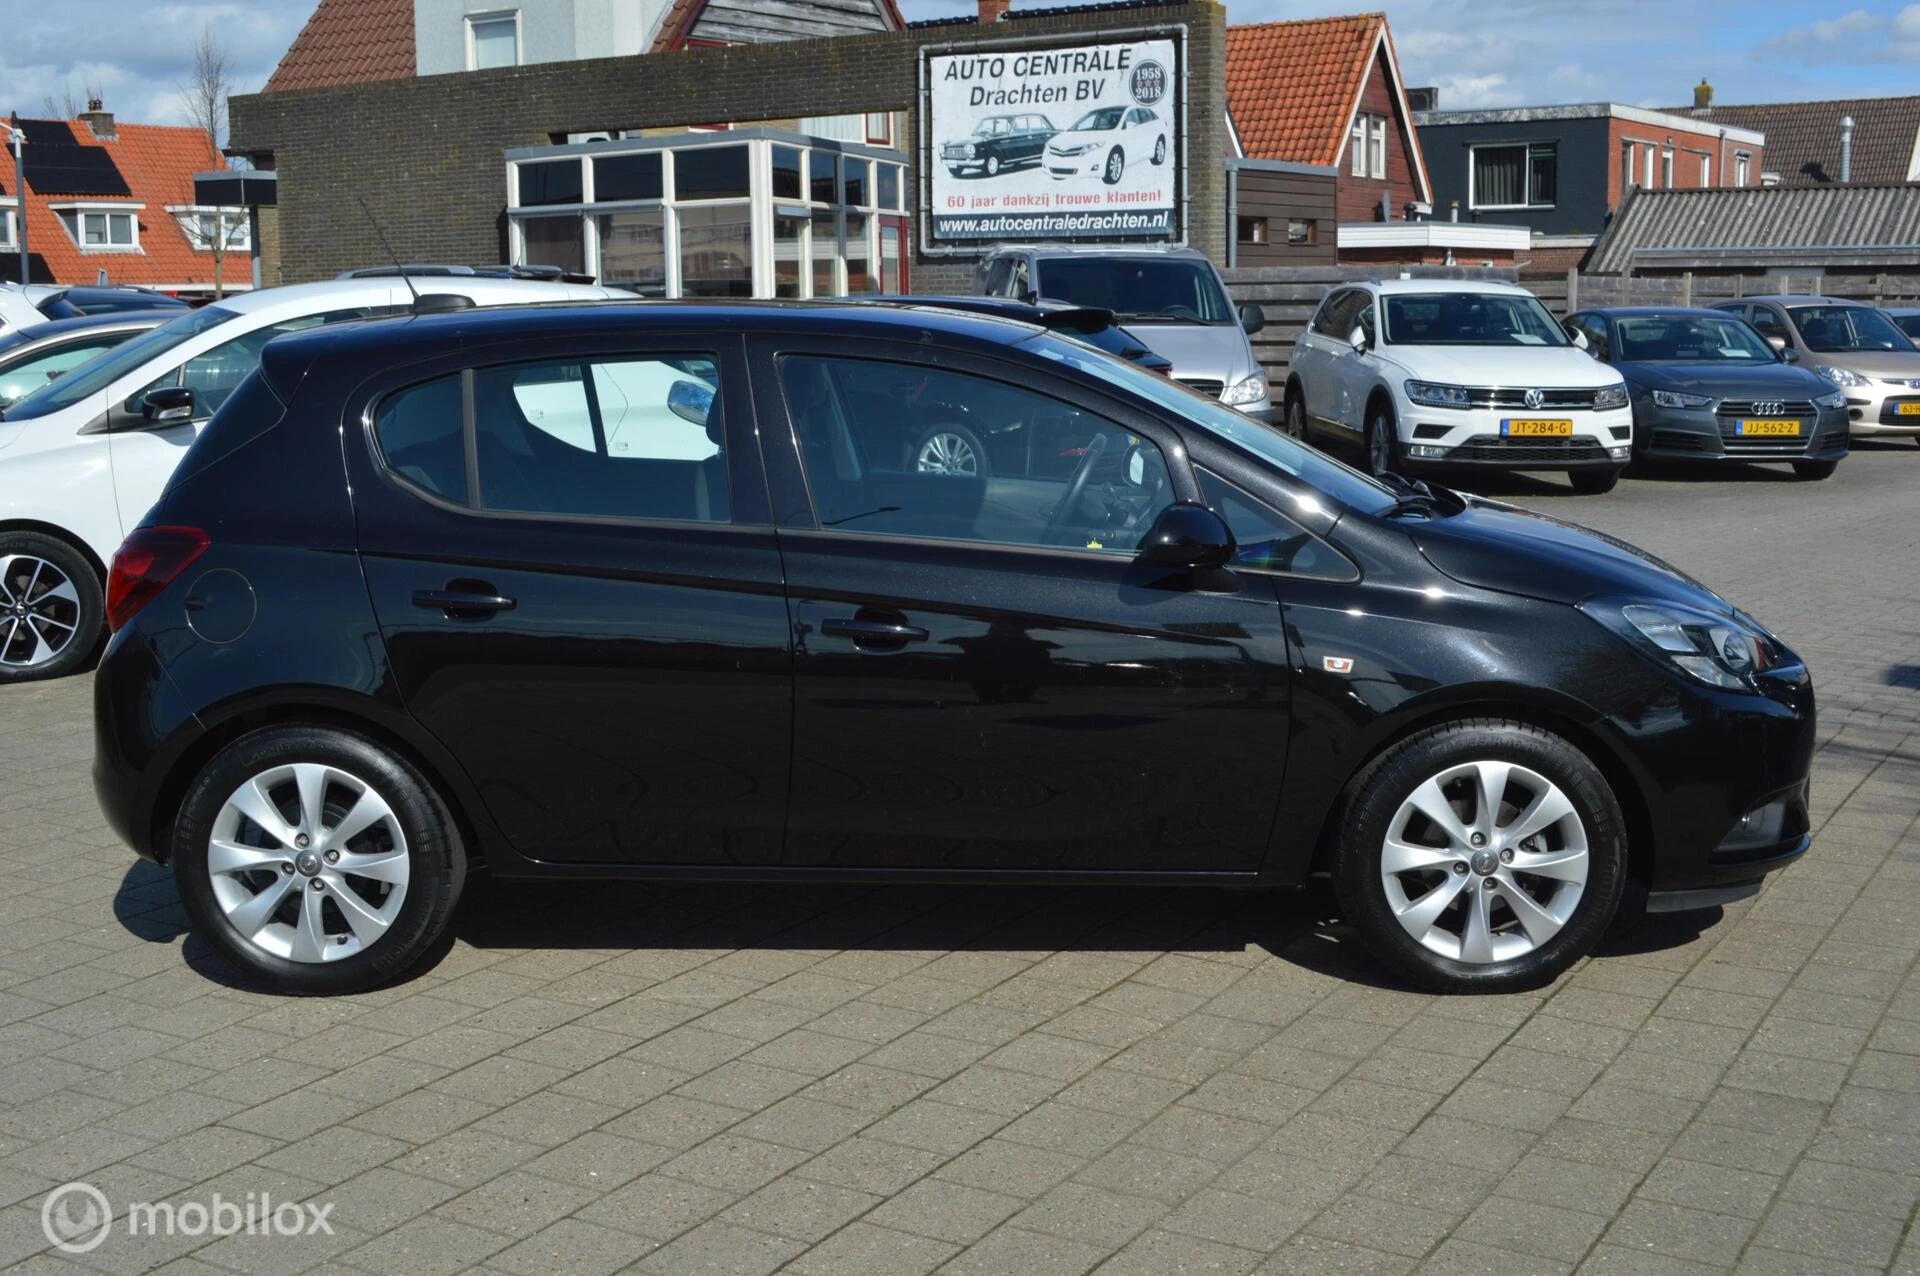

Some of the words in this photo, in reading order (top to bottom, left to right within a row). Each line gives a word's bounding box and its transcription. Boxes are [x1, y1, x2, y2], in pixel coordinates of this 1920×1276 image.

[945, 58, 1005, 81] AUTO
[1013, 48, 1132, 76] CENTRALE
[1135, 67, 1161, 80] 1958
[969, 83, 1068, 107] Drachten
[1075, 78, 1105, 100] BV
[1135, 86, 1162, 99] 2018
[947, 195, 965, 208] 60
[970, 195, 997, 209] jaar
[1002, 193, 1050, 208] dankzij
[1055, 191, 1101, 205] trouwe
[1106, 189, 1162, 204] klanten!
[939, 211, 1169, 233] www.autocentraledrachten.nl
[1513, 422, 1567, 434] JT-284-G
[1747, 423, 1794, 433] JJ-562-Z
